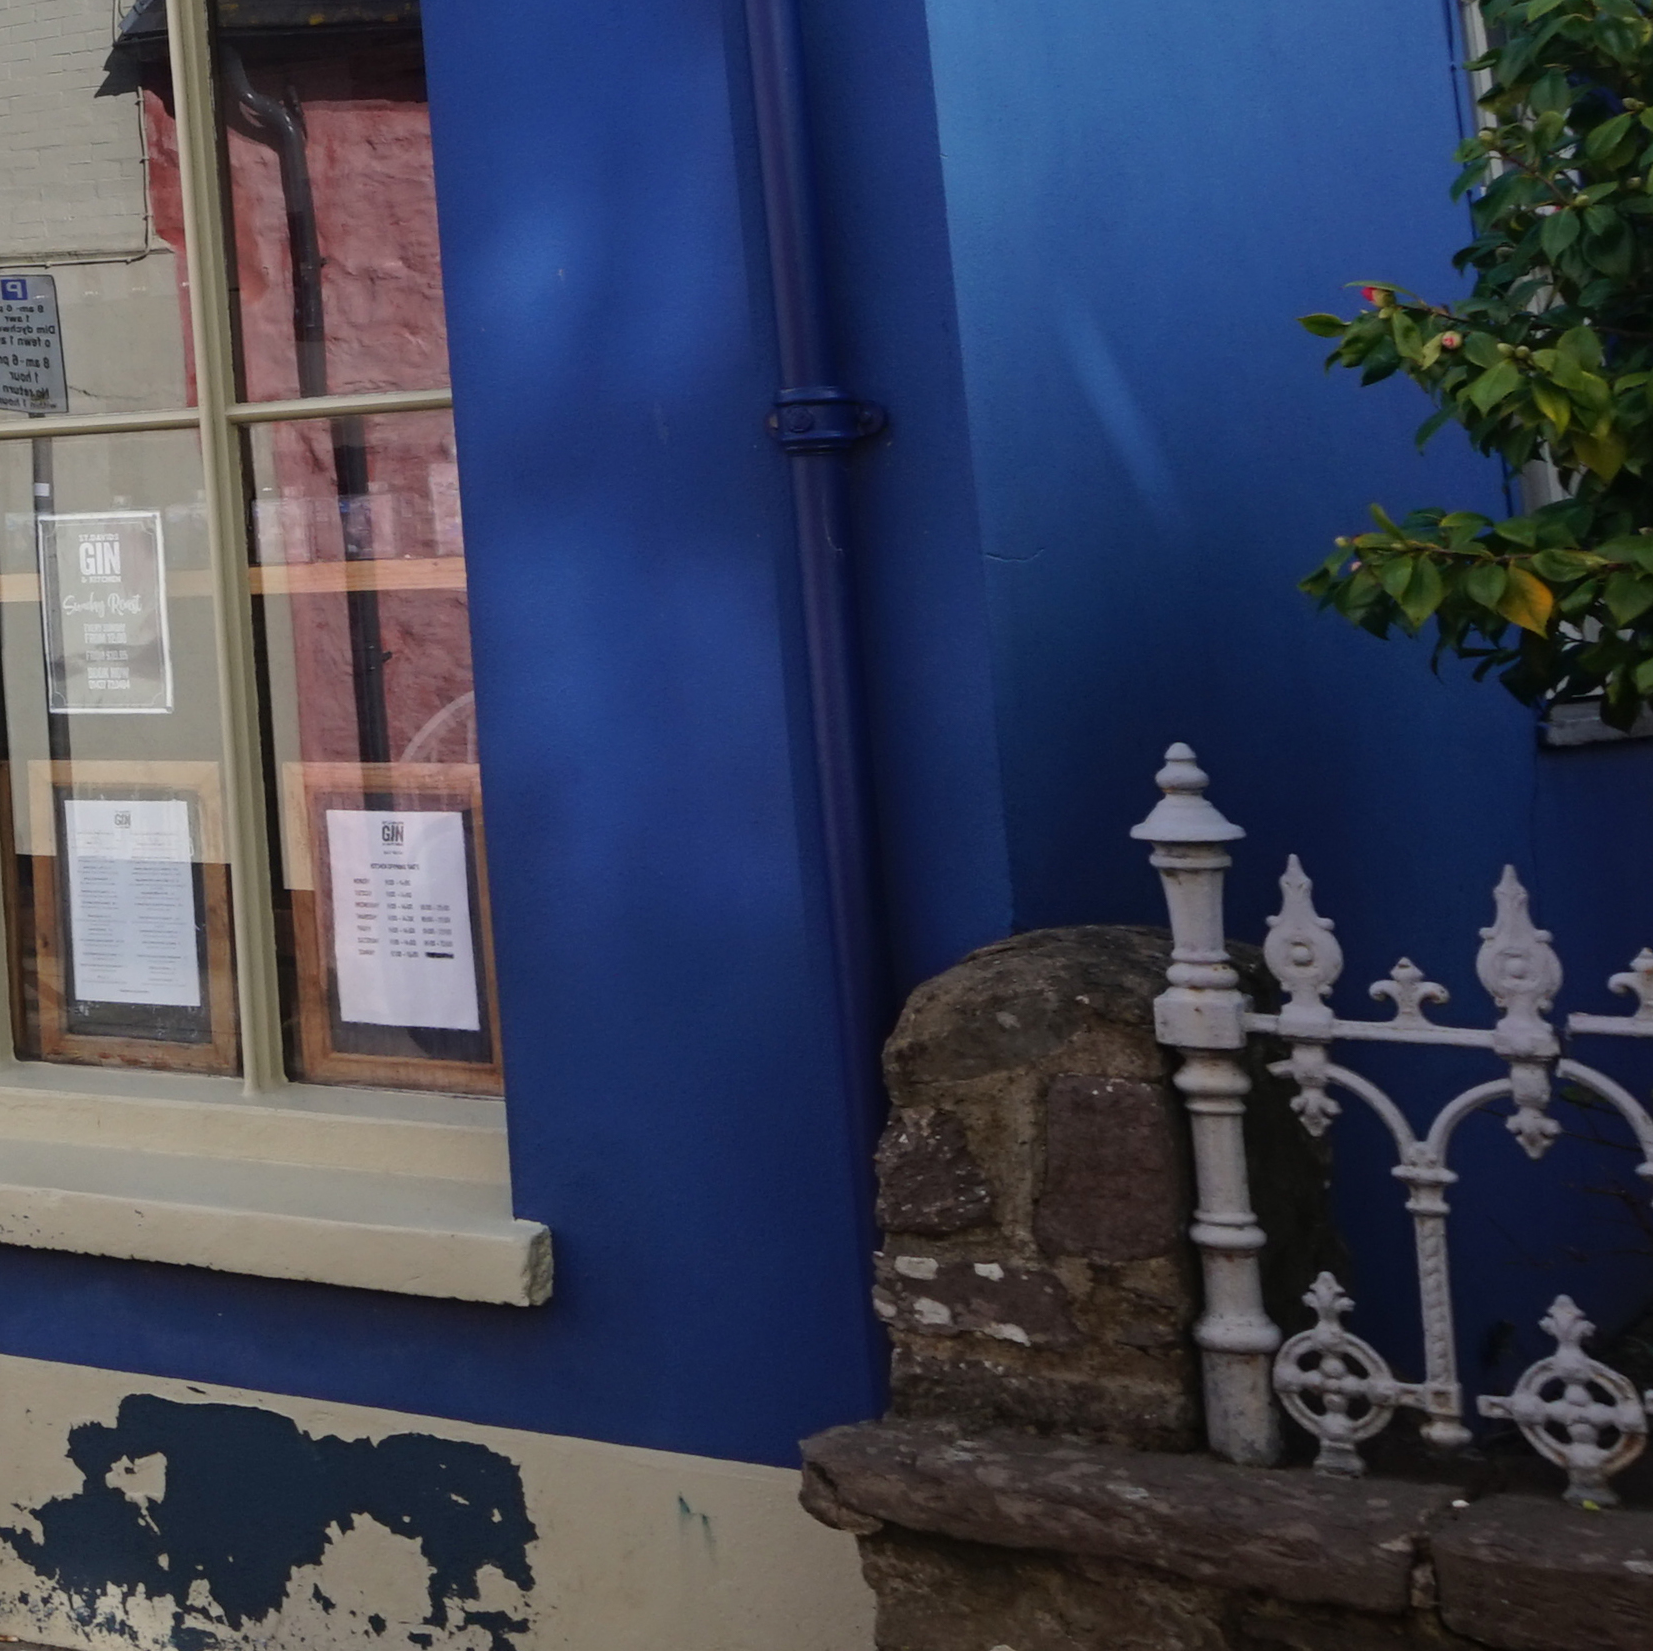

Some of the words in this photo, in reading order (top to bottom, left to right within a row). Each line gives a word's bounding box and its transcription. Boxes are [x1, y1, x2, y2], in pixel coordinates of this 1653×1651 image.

[79, 542, 121, 575] GIN
[63, 592, 105, 618] Sunday
[108, 593, 142, 616] Roast
[382, 824, 404, 842] GIN
